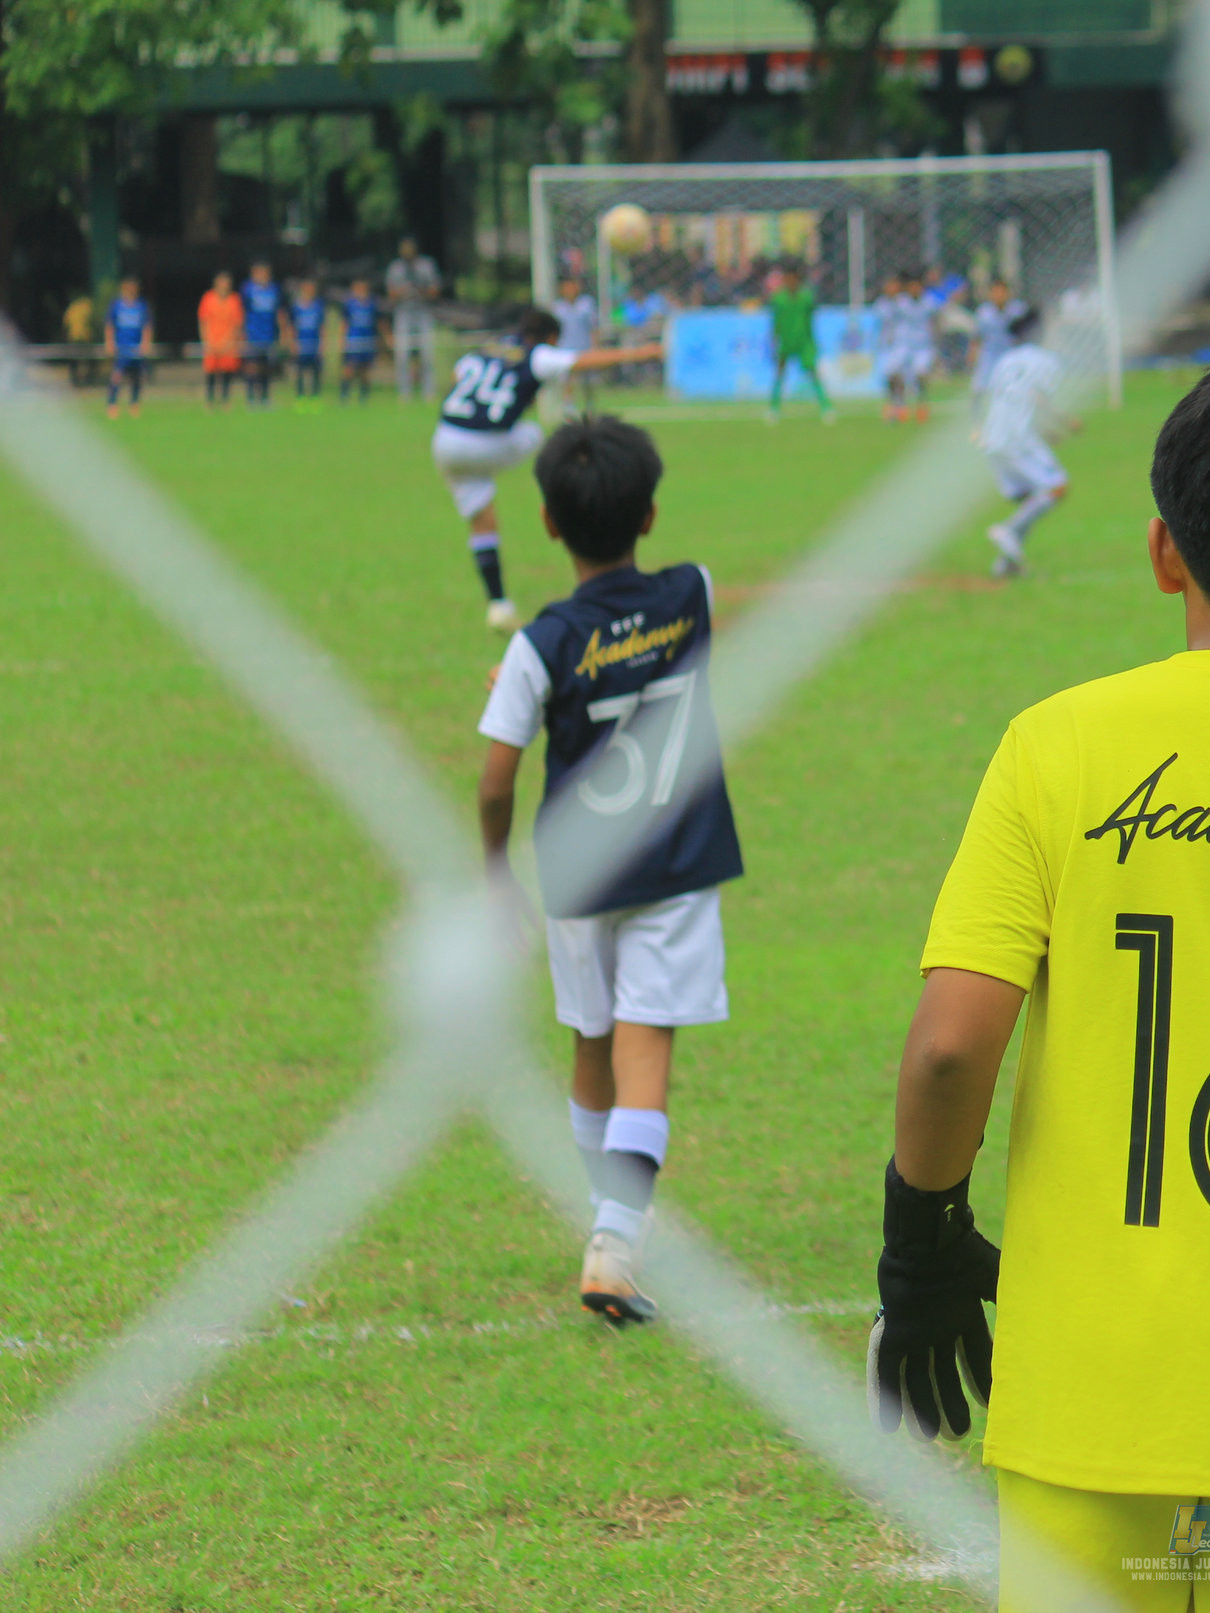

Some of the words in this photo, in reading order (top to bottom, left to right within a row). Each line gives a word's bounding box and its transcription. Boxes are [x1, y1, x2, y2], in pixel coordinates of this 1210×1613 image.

[443, 354, 519, 422] 24
[575, 617, 694, 681] Academy
[577, 669, 696, 816] 37
